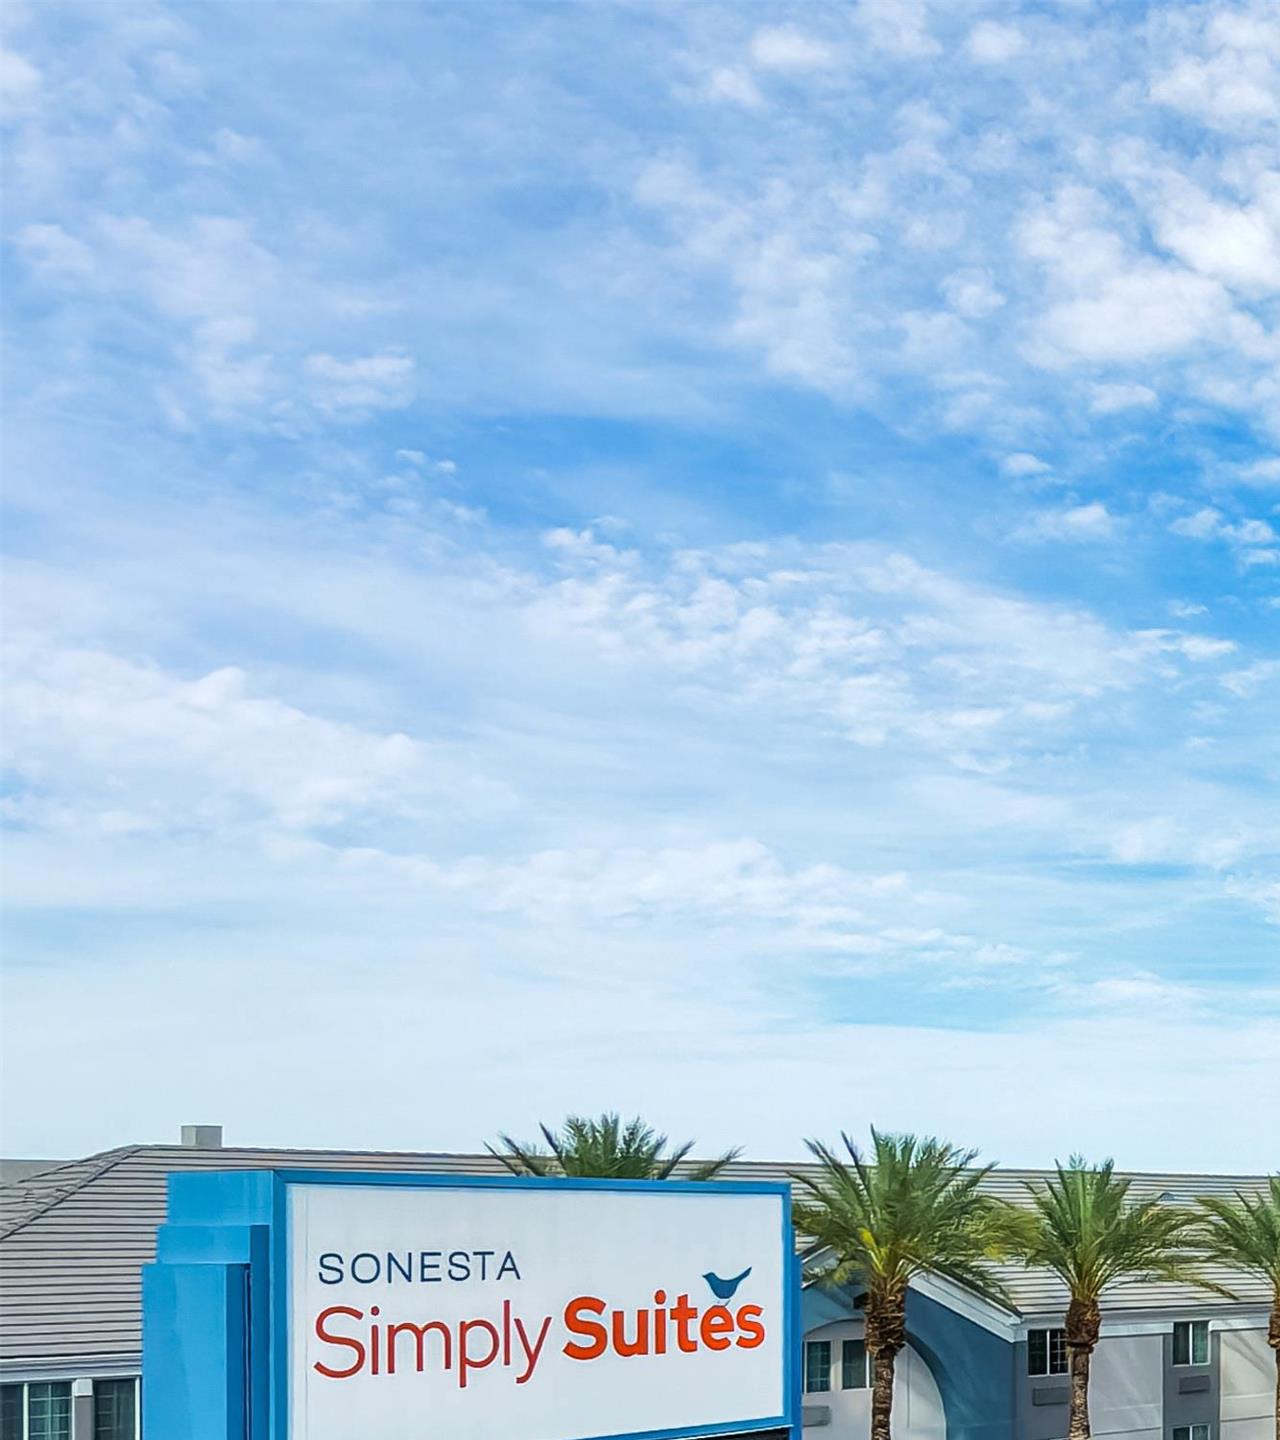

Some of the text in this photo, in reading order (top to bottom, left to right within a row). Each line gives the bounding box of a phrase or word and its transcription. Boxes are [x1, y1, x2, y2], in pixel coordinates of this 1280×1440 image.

[318, 1251, 521, 1284] SONESTA
[313, 1289, 766, 1389] Simply Suites
